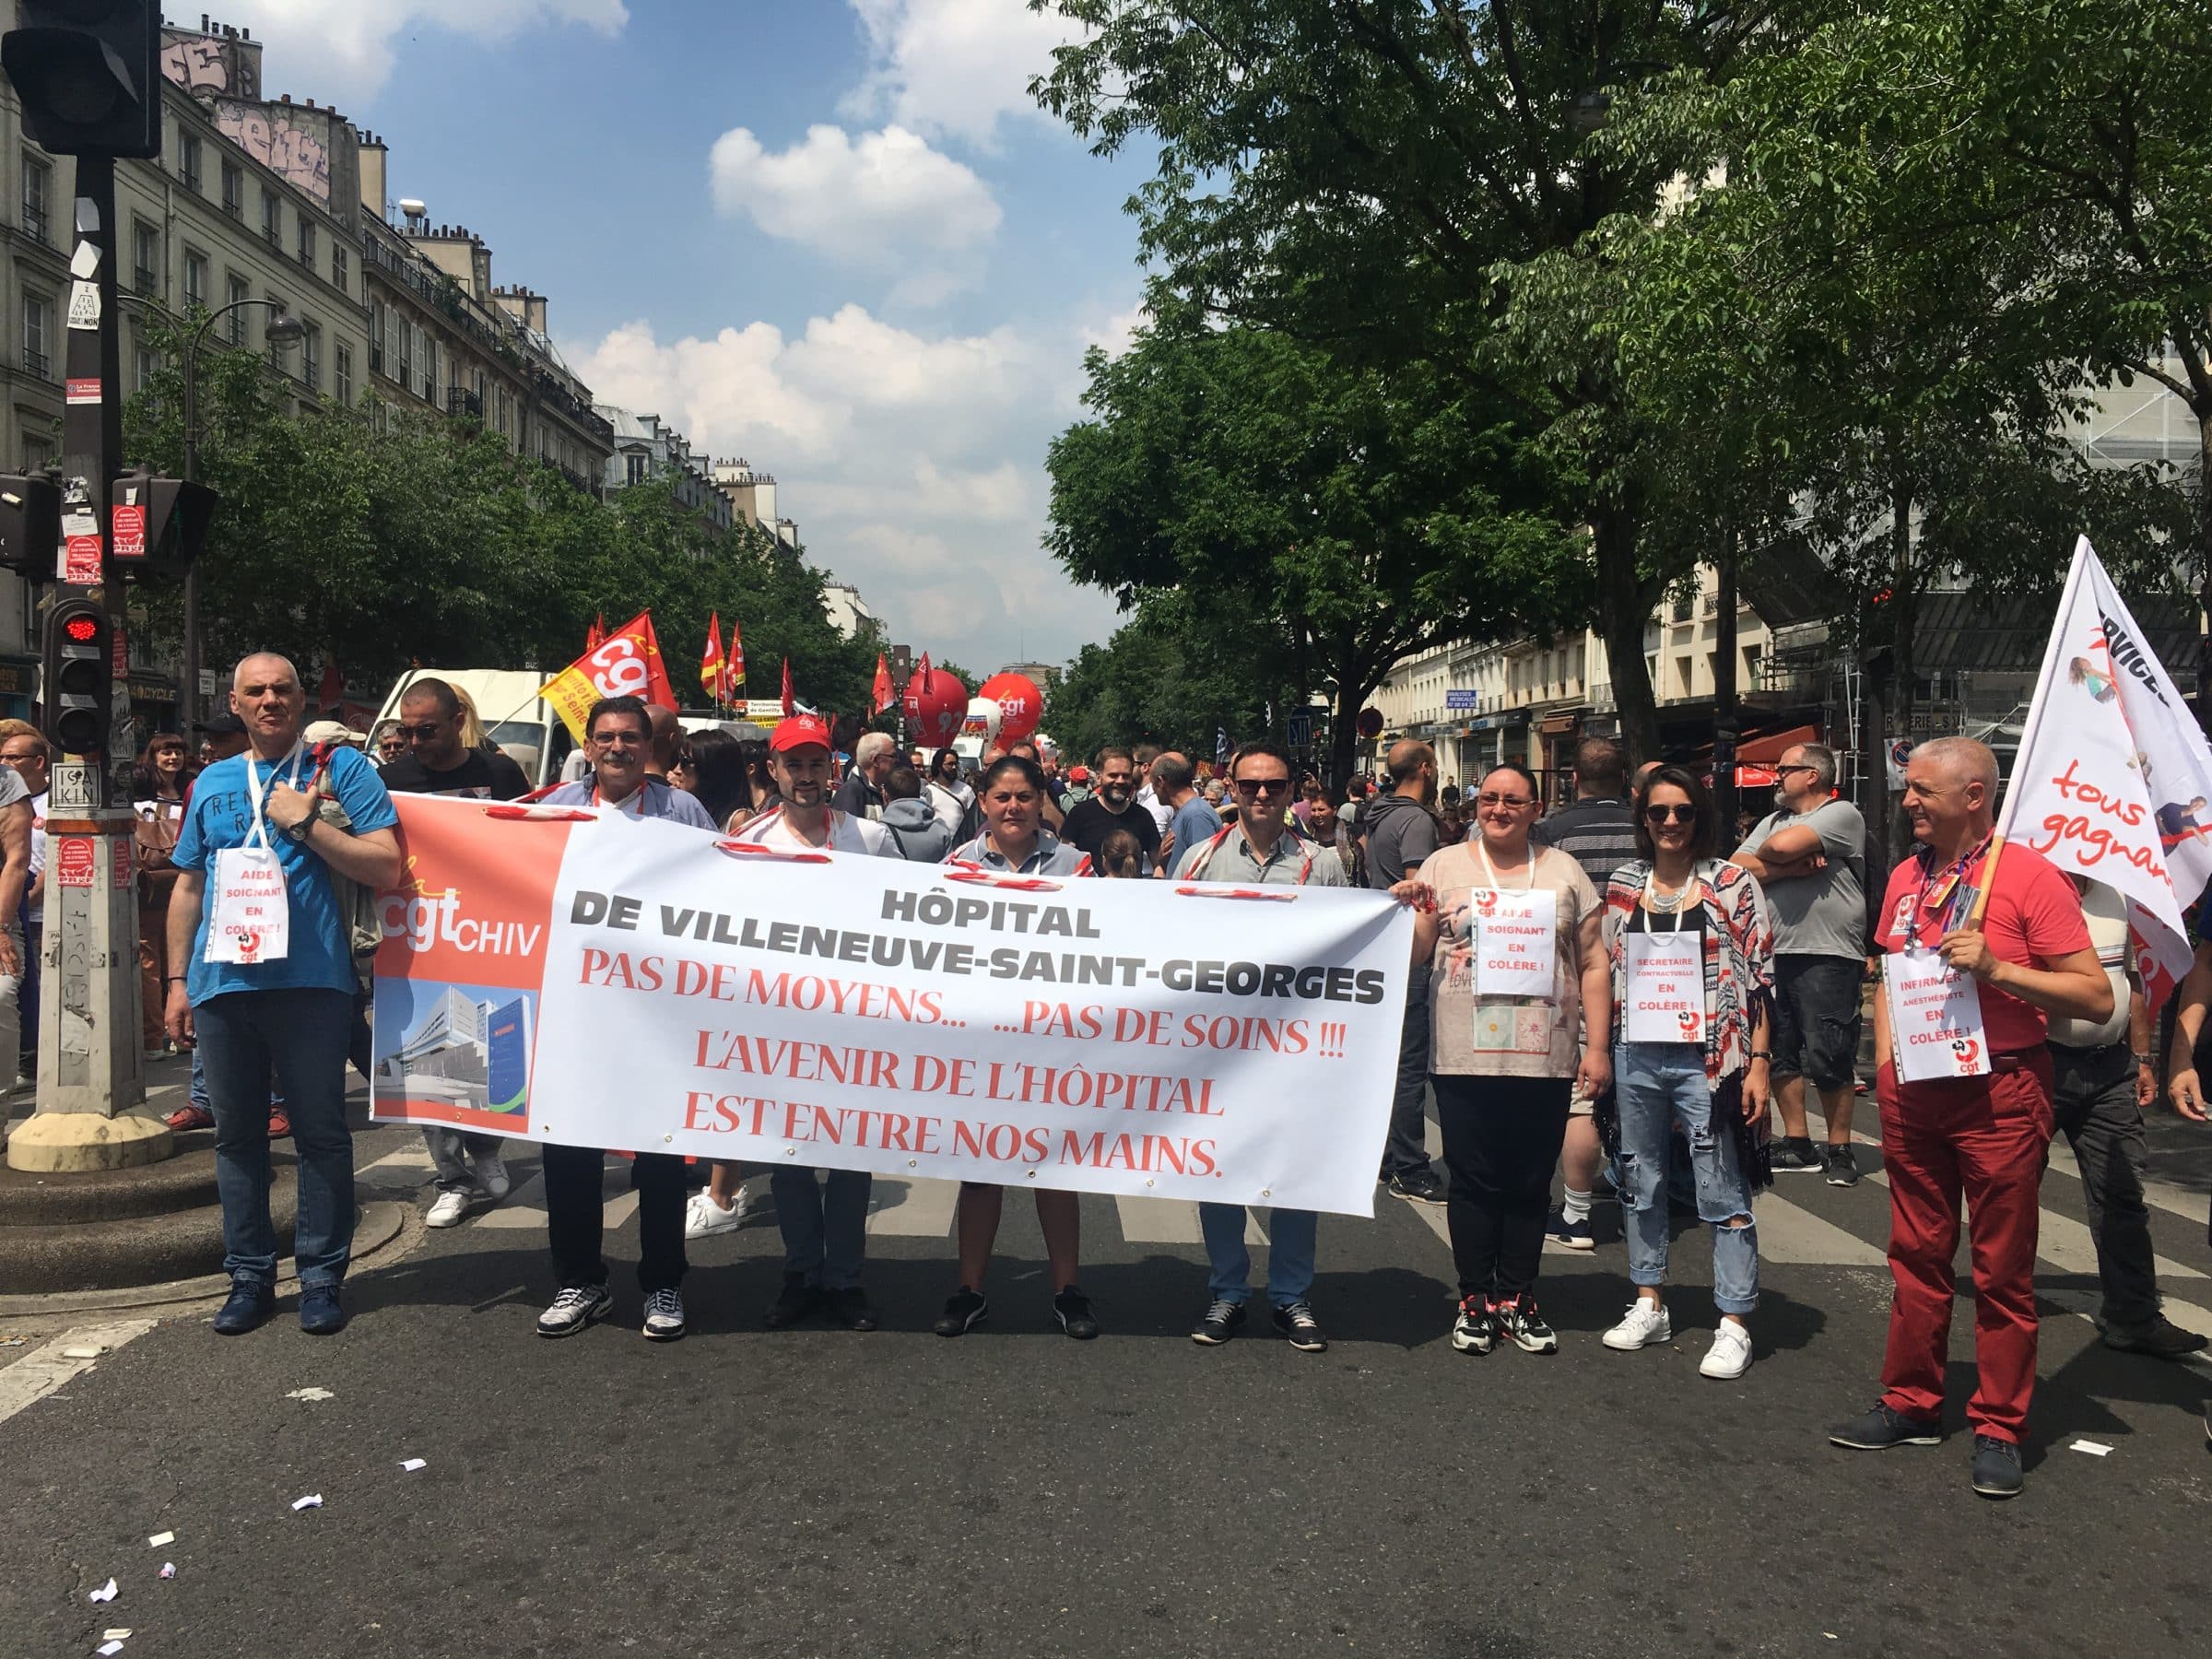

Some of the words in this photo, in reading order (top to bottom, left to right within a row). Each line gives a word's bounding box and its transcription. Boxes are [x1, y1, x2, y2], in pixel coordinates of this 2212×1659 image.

[996, 698, 1026, 716] cgt
[938, 712, 963, 734] 92
[61, 787, 93, 805] KIN
[2052, 759, 2147, 827] tous
[2029, 812, 2173, 890] gagnan
[241, 870, 274, 880] AIDE
[226, 887, 281, 898] SOIGNANT
[245, 906, 263, 915] EN
[880, 887, 1100, 938] HÔPITAL
[1478, 909, 1496, 918] cgt
[376, 888, 461, 953] cgt
[454, 919, 541, 957] CHIV
[1487, 925, 1547, 935] SOIGNANT
[570, 890, 642, 931] DE
[659, 904, 1384, 1005] VILLENEUVE-SAINT-GEORGES
[1508, 943, 1525, 953] EN
[241, 952, 258, 963] cgt
[1658, 983, 1675, 993] EN
[579, 947, 665, 992] PAS
[673, 959, 737, 1003] DE
[744, 968, 967, 1029] MOYENS...
[994, 1000, 1104, 1041] ...PAS
[1113, 1007, 1173, 1046] DE
[1181, 1013, 1310, 1057] SOINS
[1319, 1021, 1347, 1058] !!!
[1925, 1009, 1945, 1021] EN
[1682, 1030, 1699, 1041] cgt
[1909, 1028, 1963, 1045] COLÈRE
[693, 1030, 900, 1089] L'AVENIR
[911, 1054, 977, 1100] DE
[985, 1062, 1225, 1117] L'HÔPITAL
[1959, 1062, 1980, 1077] cgt
[681, 1090, 776, 1136] EST
[782, 1101, 942, 1156] ENTRE
[950, 1119, 1050, 1164] NOS
[1060, 1129, 1223, 1179] MAINS.
